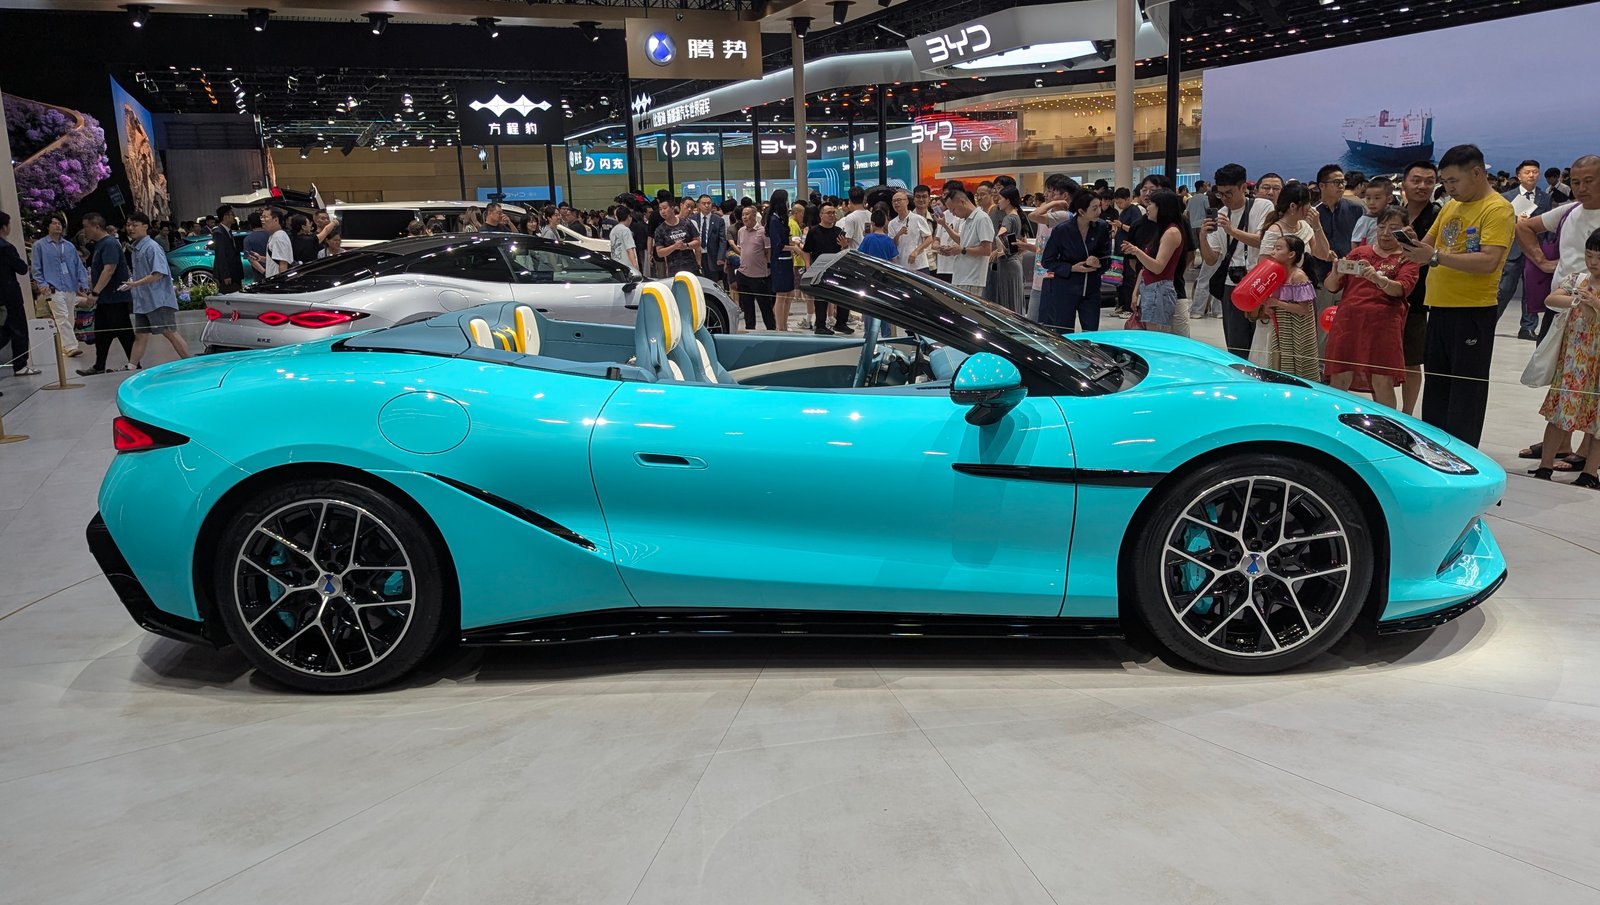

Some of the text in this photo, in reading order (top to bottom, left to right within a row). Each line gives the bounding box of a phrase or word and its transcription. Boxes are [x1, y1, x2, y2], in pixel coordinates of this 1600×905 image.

[688, 39, 747, 59] 腾势
[925, 24, 991, 63] BYD
[488, 122, 537, 135] 方程豹
[911, 121, 953, 143] BYD
[686, 141, 715, 156] 闪充
[761, 140, 817, 154] BYD
[600, 157, 624, 170] 闪充
